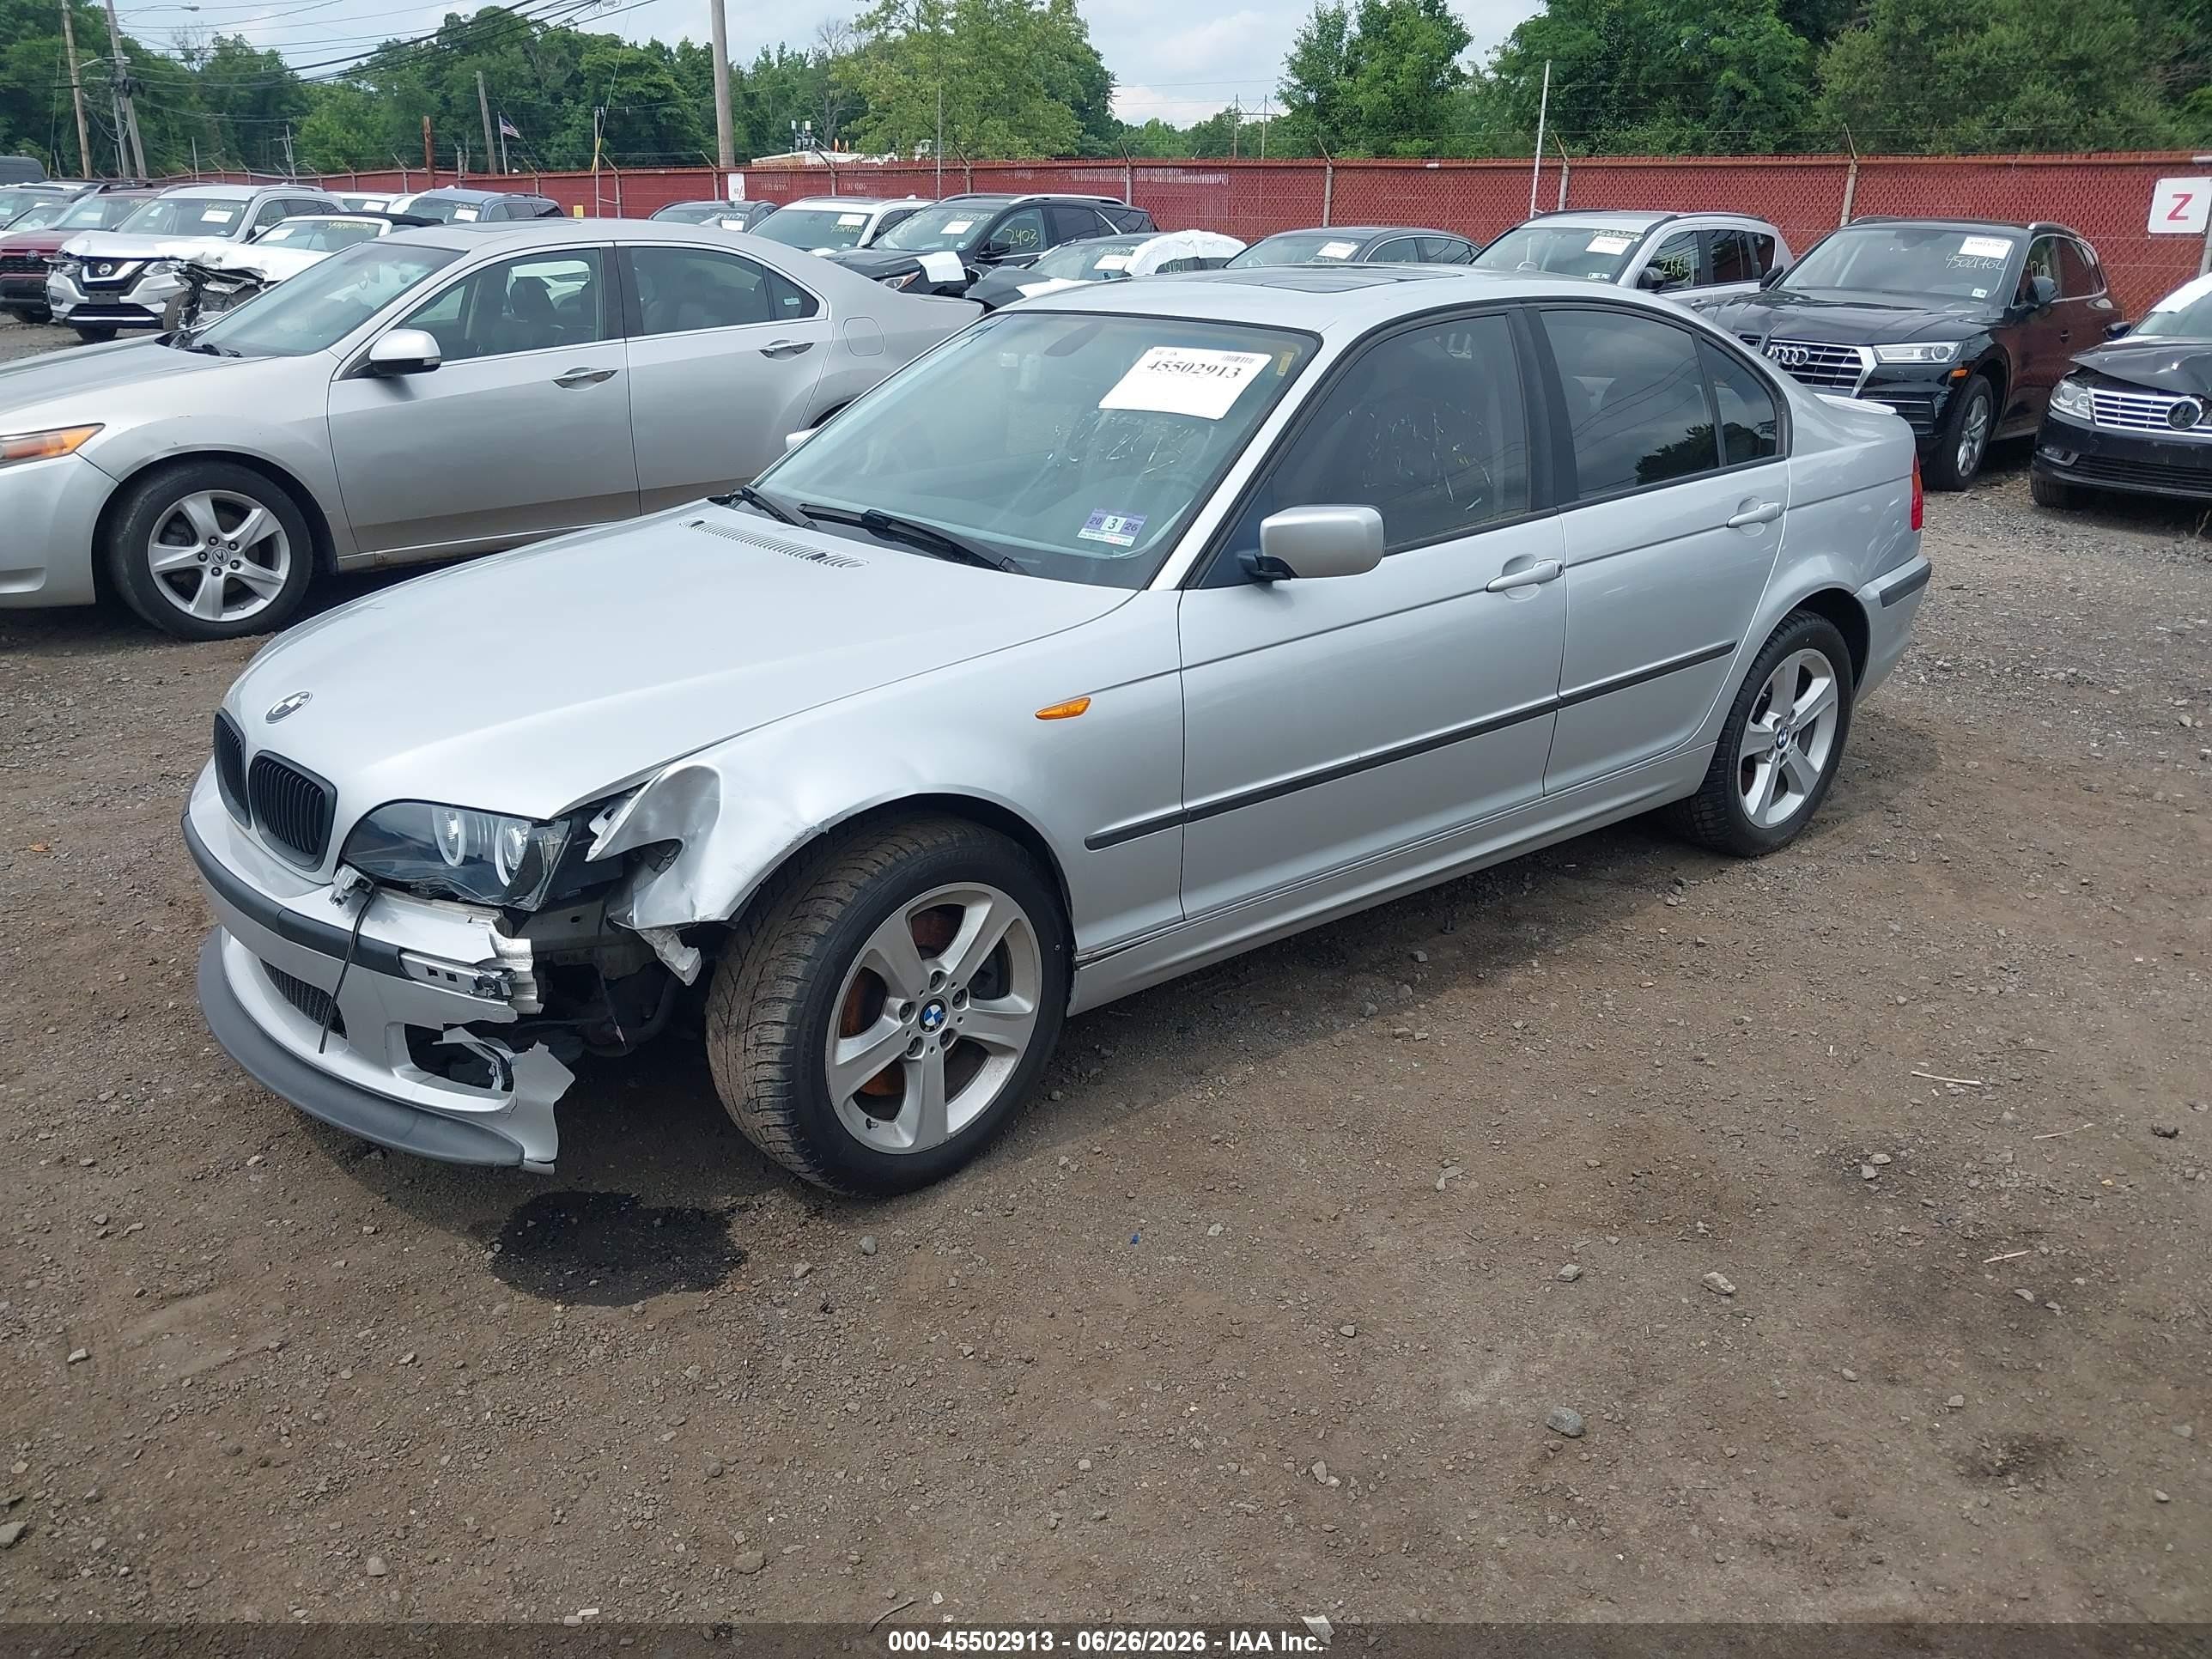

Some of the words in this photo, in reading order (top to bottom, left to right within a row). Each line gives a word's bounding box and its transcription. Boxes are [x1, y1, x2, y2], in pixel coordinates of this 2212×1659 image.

[2166, 193, 2193, 221] Z
[1006, 228, 1038, 248] 2403
[1661, 256, 1691, 283] 2665
[1147, 361, 1242, 379] 45502913
[1089, 517, 1103, 526] 20
[1108, 518, 1119, 529] 3
[1124, 522, 1139, 532] 26
